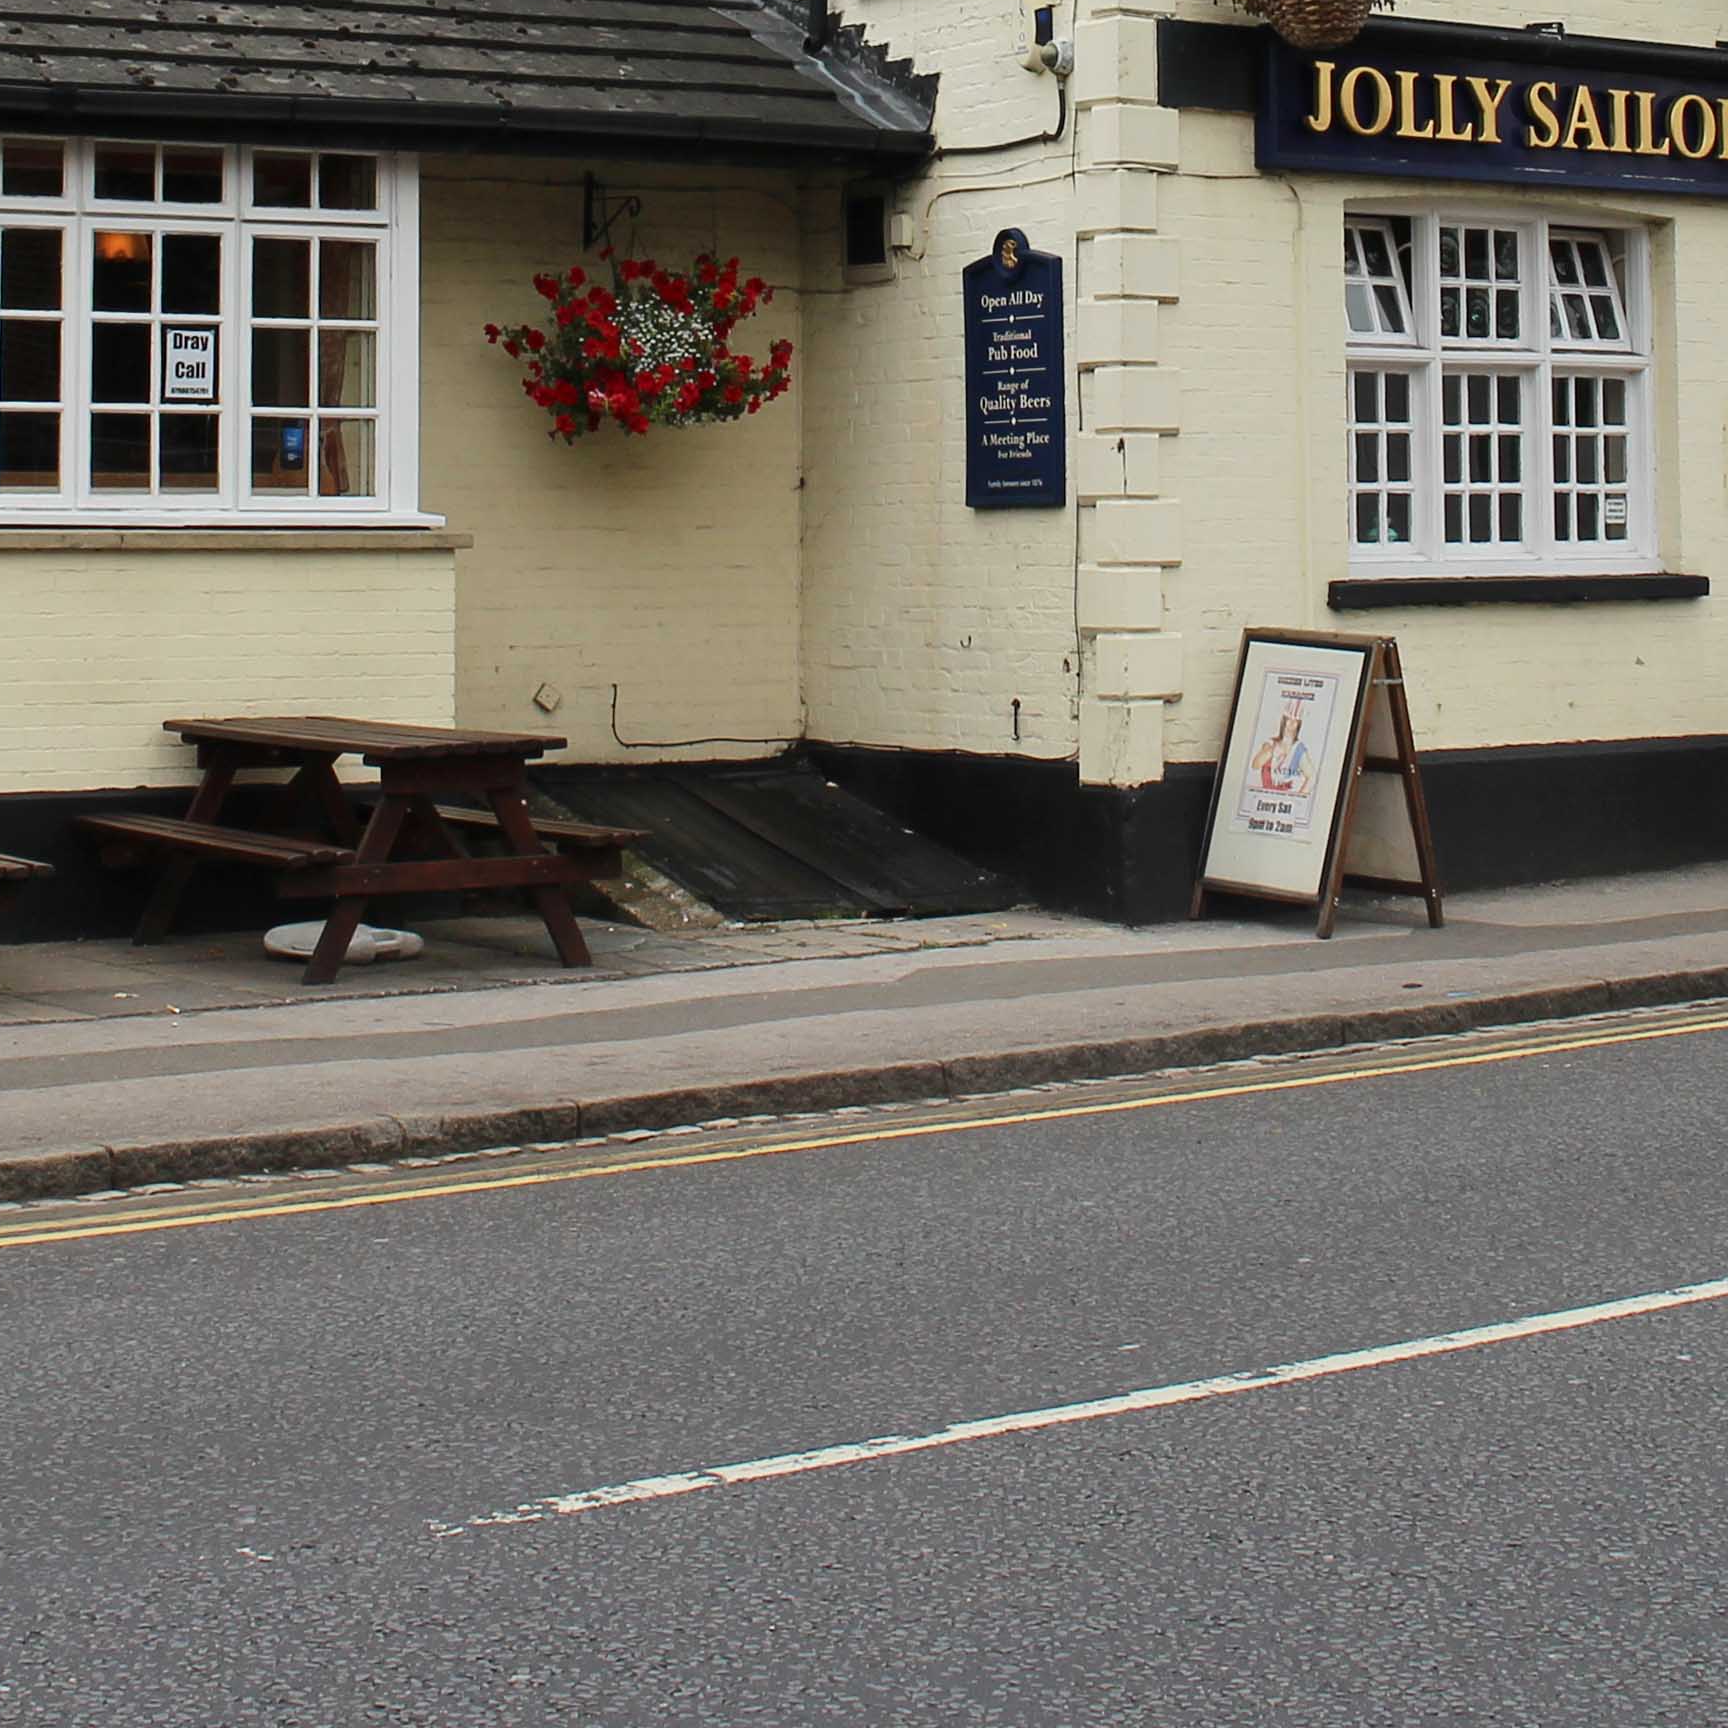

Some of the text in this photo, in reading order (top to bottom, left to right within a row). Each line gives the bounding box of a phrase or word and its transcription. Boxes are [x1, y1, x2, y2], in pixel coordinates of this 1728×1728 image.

[1306, 60, 1512, 144] JOLLY
[981, 290, 1044, 312] Open All Day
[173, 332, 209, 351] Dray
[988, 342, 1039, 361] Pub Food
[175, 361, 206, 379] Call
[998, 381, 1018, 394] Range
[980, 393, 1051, 415] Quality Beers
[982, 432, 1050, 449] A Meeting Place
[1257, 800, 1292, 814] Every Sat
